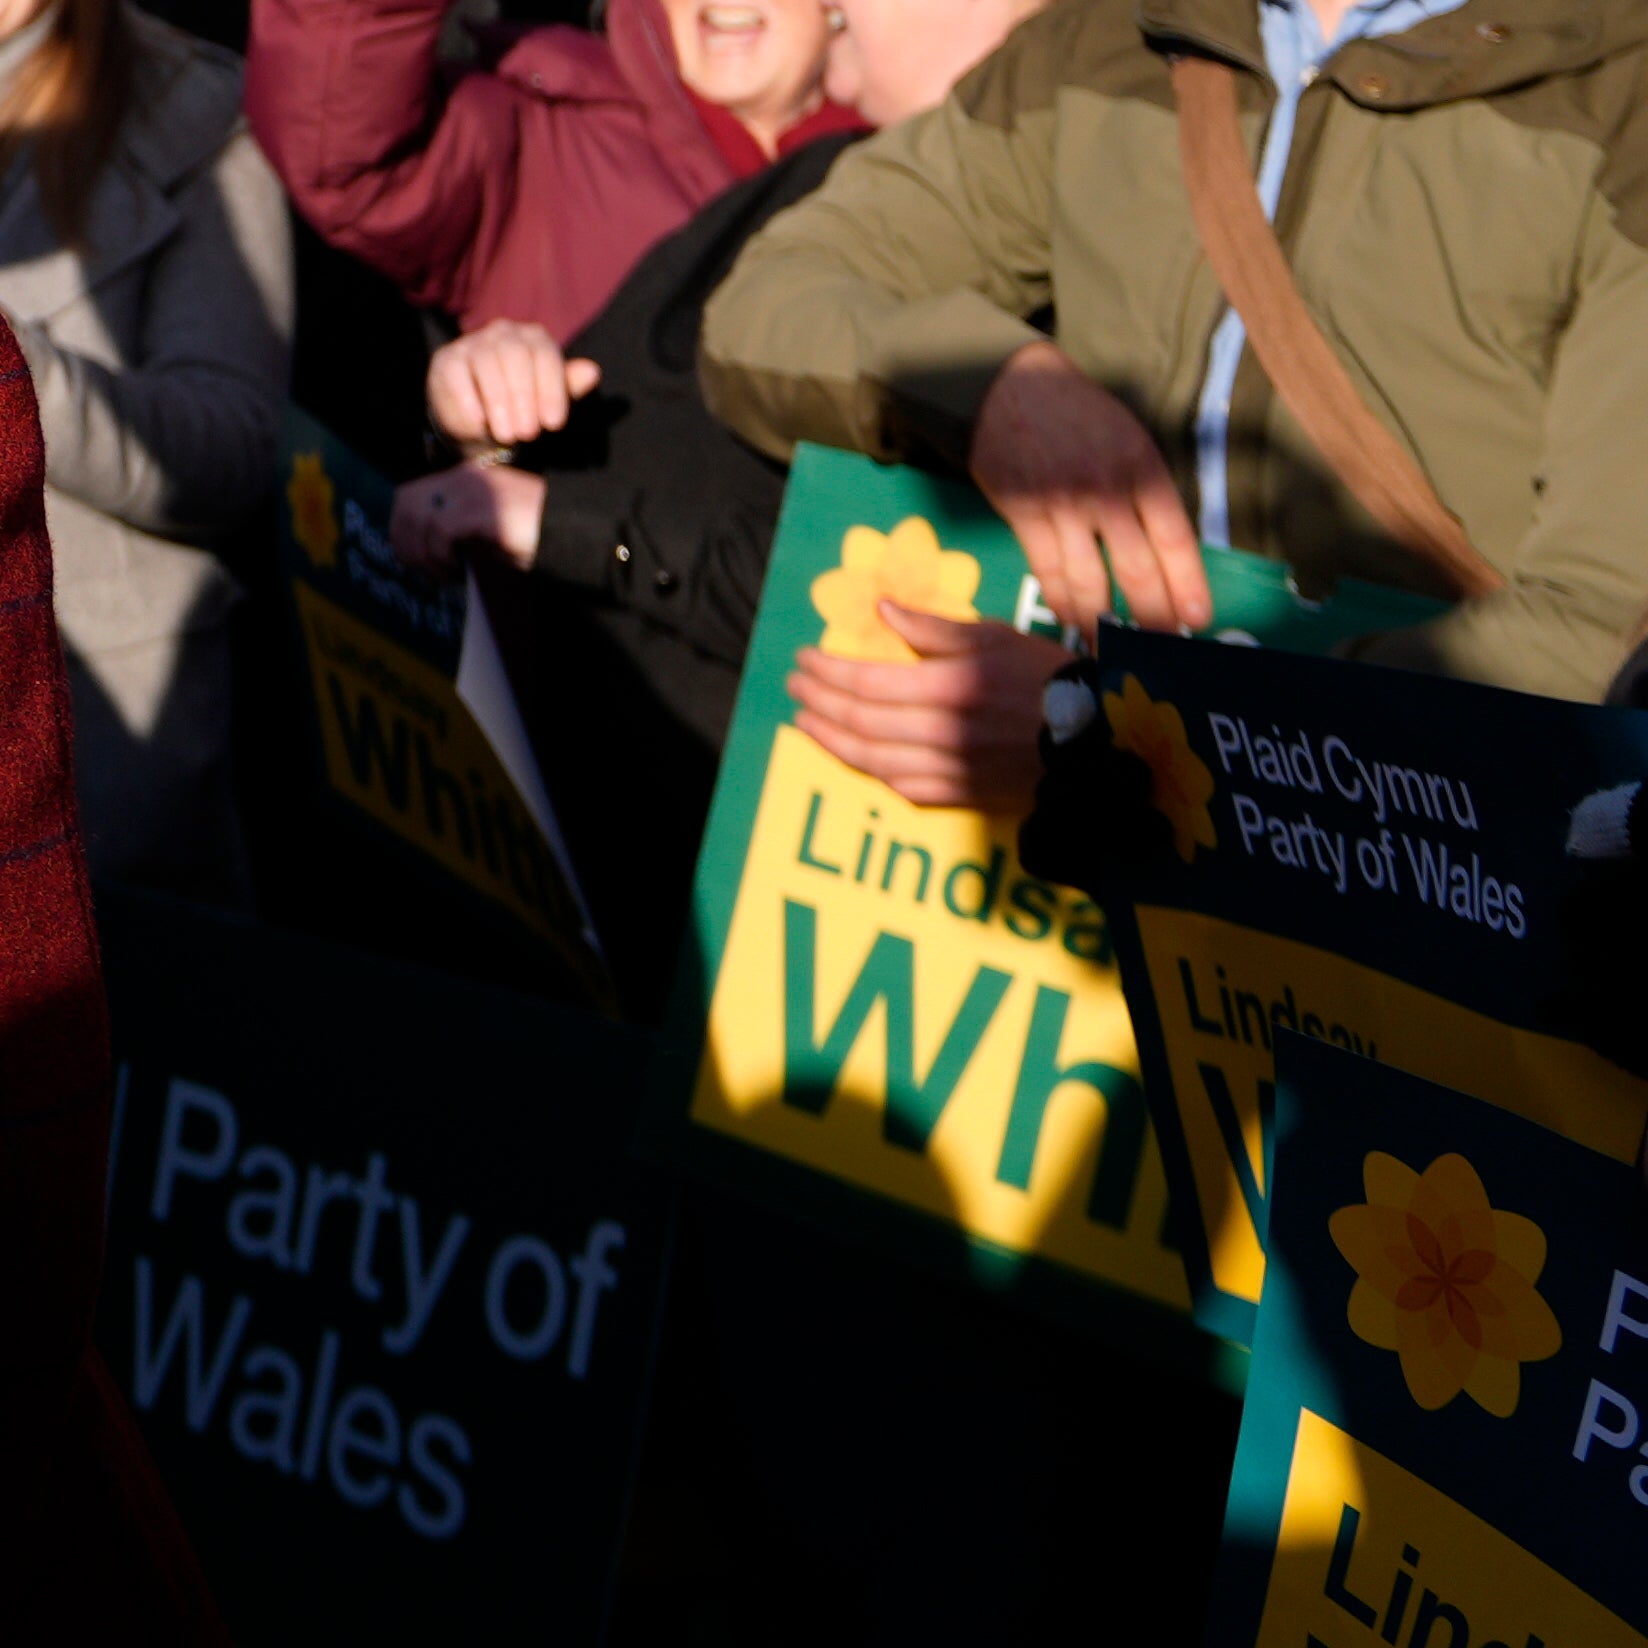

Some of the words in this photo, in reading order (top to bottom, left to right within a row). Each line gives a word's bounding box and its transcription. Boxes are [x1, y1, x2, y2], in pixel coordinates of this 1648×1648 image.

[1208, 712, 1323, 795] Plaid
[1323, 734, 1479, 832] Cymru
[1232, 792, 1346, 895] Party
[1356, 828, 1400, 897] of
[1404, 835, 1527, 940] Wales
[781, 895, 1178, 1250] Wh
[151, 1077, 471, 1354] Party
[485, 1219, 627, 1380] of
[133, 1255, 474, 1540] Wales
[1324, 1503, 1548, 1648] Lin
